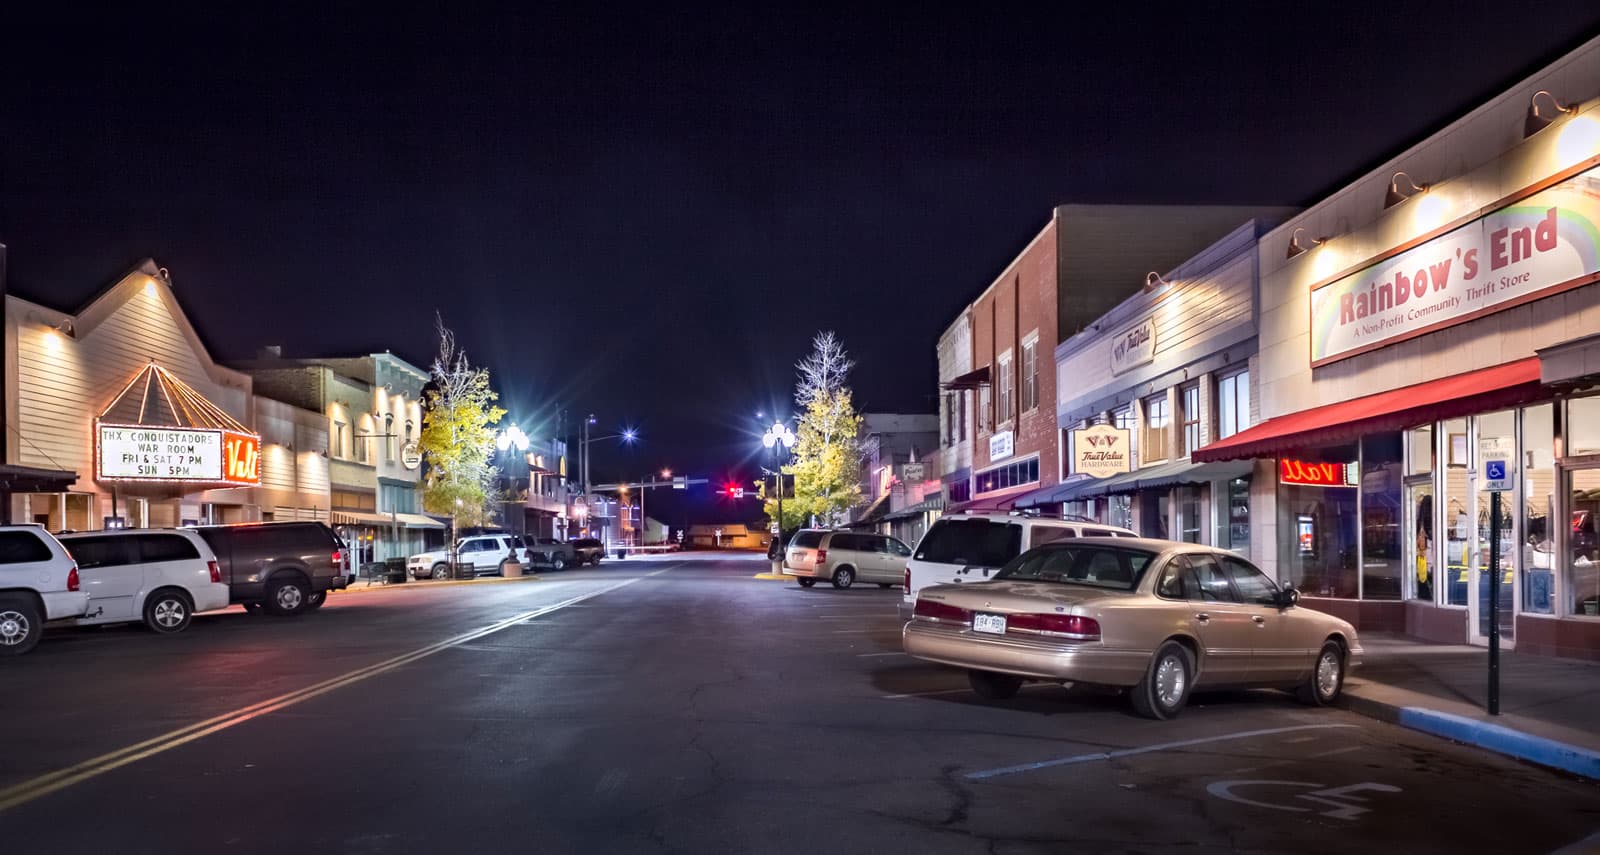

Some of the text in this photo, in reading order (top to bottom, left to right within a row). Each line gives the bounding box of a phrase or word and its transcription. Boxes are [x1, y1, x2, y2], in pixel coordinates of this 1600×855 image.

[1340, 206, 1557, 326] Rainbow's End
[1353, 270, 1530, 338] A Non-Profit Community Thrift Store
[131, 432, 213, 445] CONQUISTADORS
[138, 443, 195, 454] WAR ROOM
[122, 454, 202, 465] FRI & SAT 7 PM
[138, 465, 158, 475] SUN
[1487, 480, 1505, 489] ONLY
